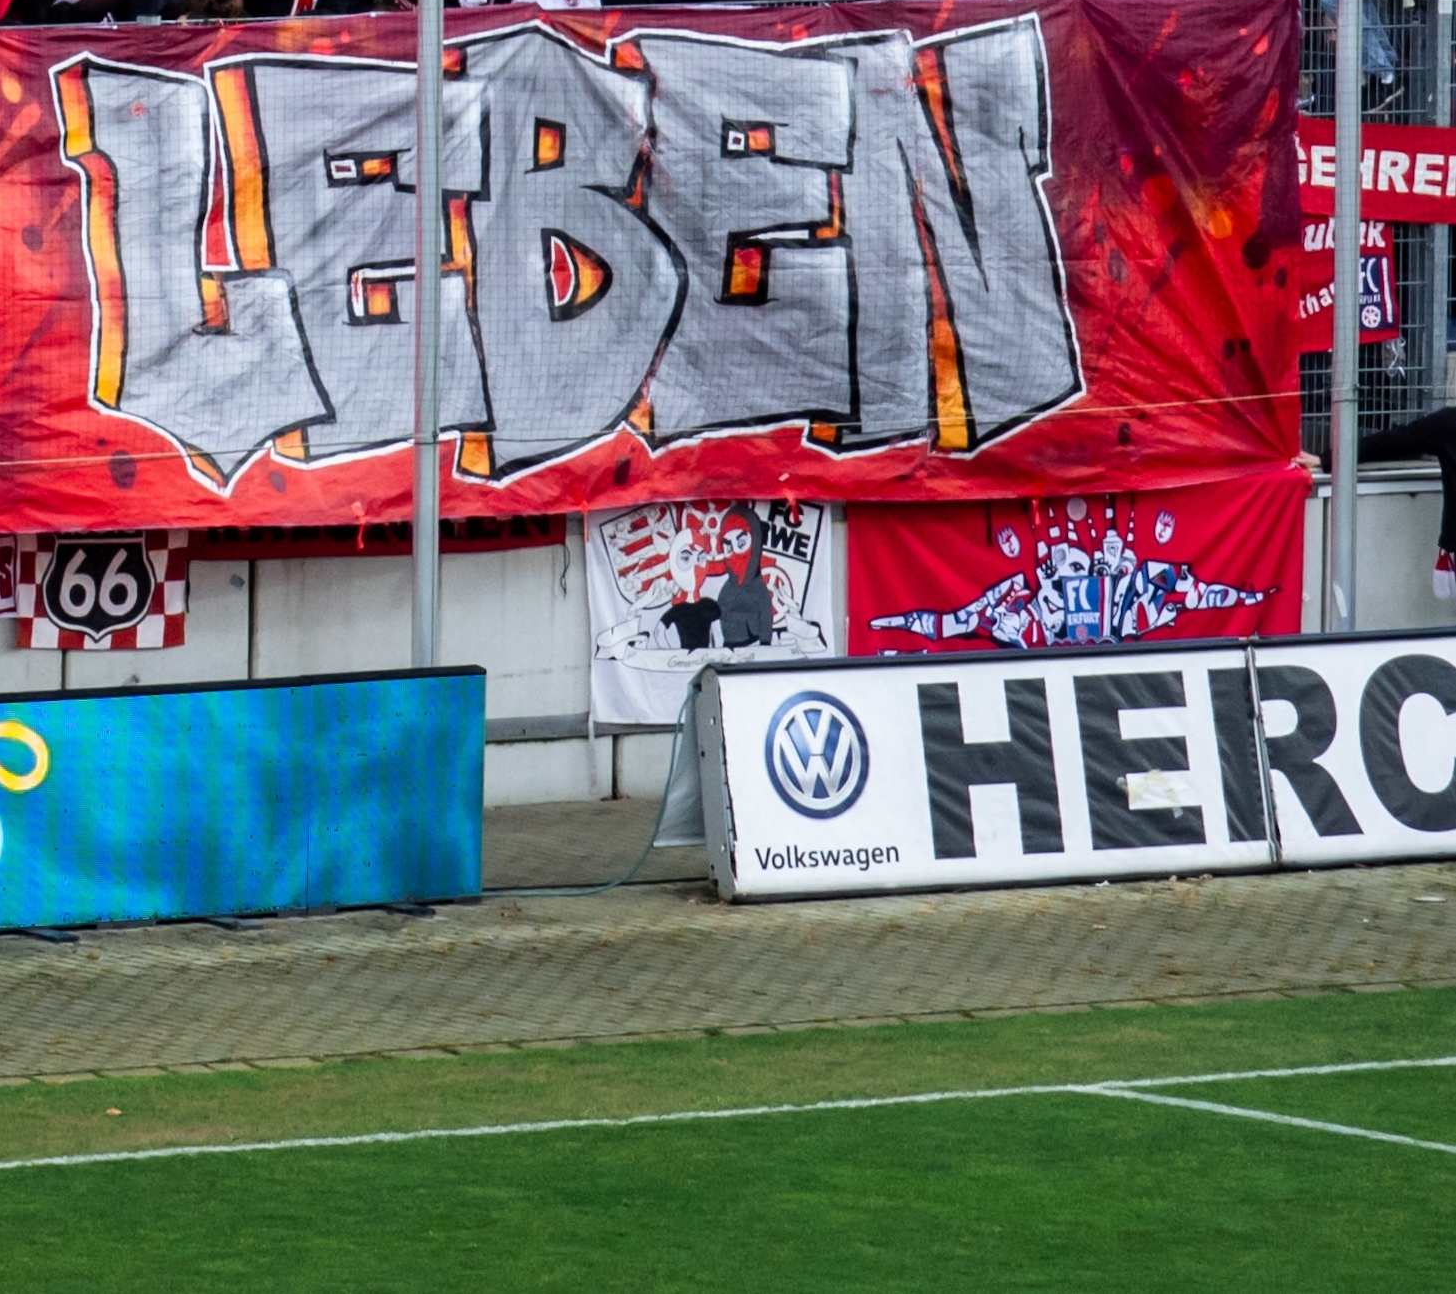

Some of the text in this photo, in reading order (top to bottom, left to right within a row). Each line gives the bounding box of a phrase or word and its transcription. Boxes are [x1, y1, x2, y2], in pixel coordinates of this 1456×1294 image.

[1296, 141, 1456, 197] EHRE
[48, 14, 1087, 495] LEBEN
[767, 499, 805, 528] FC
[59, 548, 139, 618] 66
[1067, 578, 1092, 612] FC
[1067, 612, 1100, 626] ERFURT
[754, 840, 900, 873] Volkswagen
